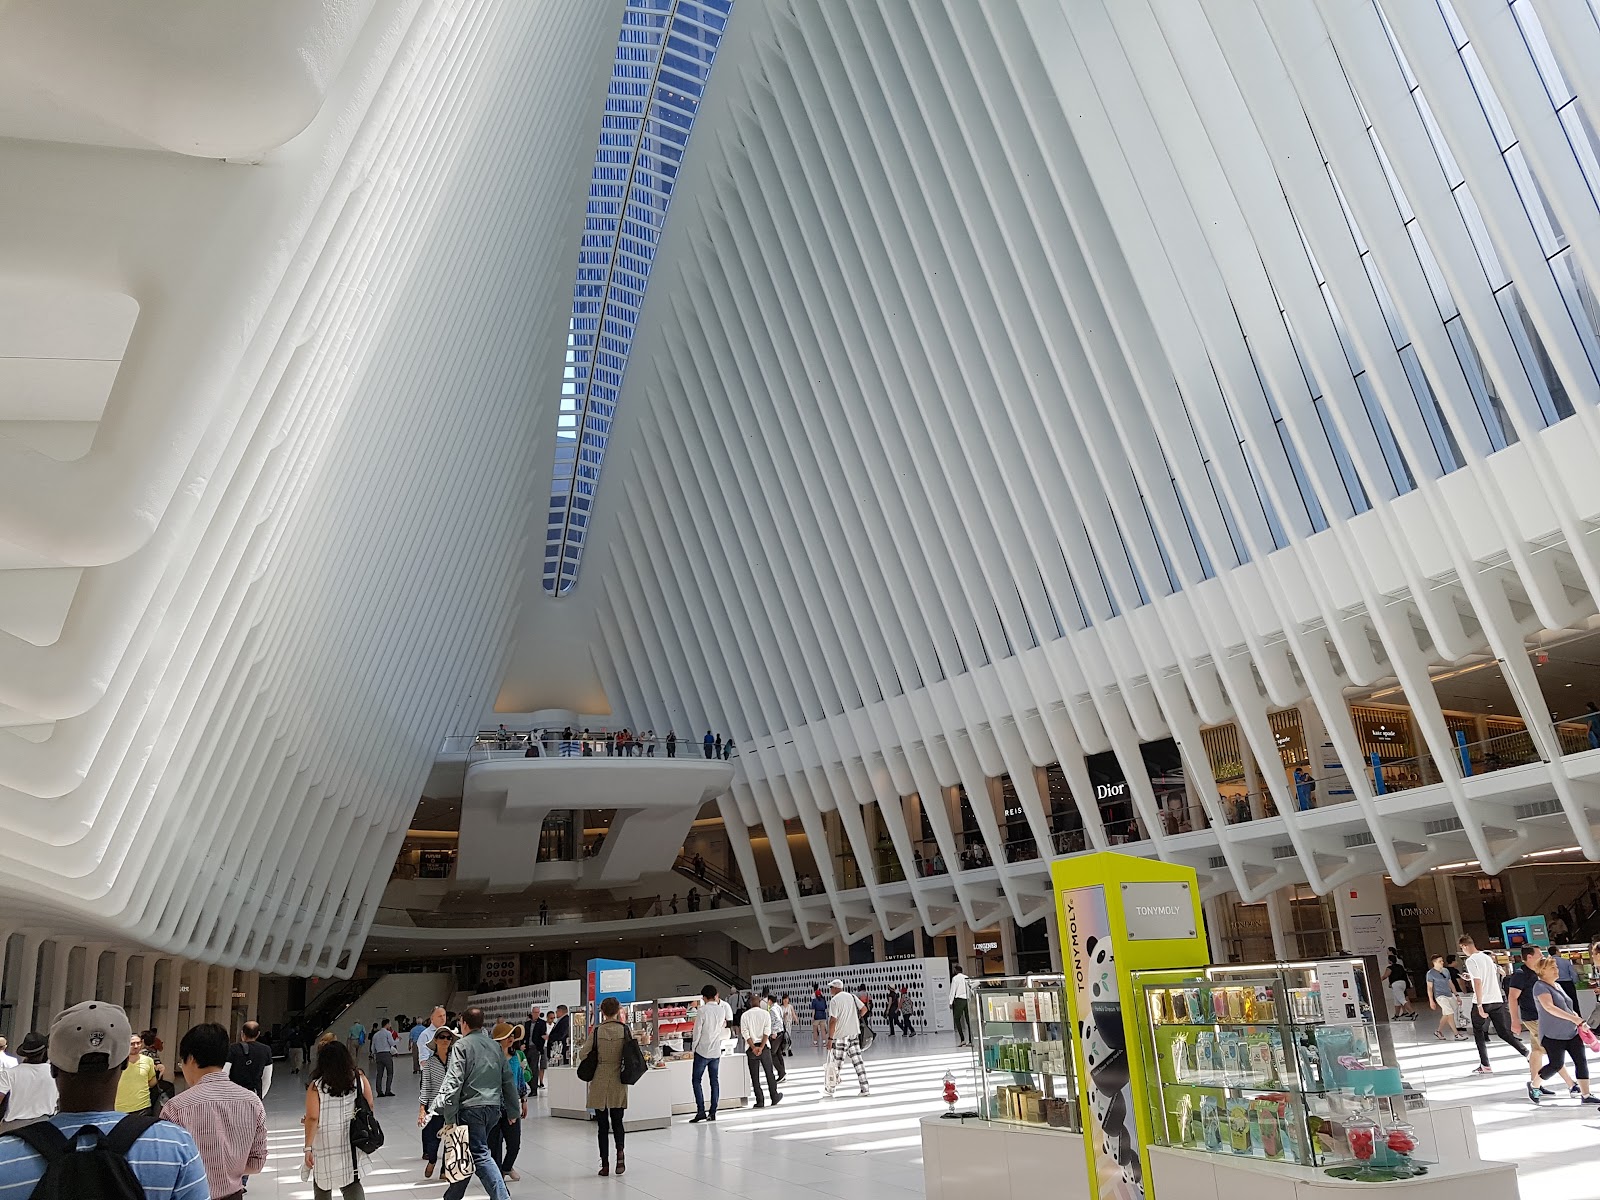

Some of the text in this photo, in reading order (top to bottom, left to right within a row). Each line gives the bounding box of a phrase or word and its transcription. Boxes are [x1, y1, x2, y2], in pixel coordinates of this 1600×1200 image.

[1097, 783, 1125, 800] Dior
[1136, 906, 1180, 916] TONYMOLY
[1067, 902, 1085, 993] TONYMOLY
[885, 953, 915, 961] SMYTHSON
